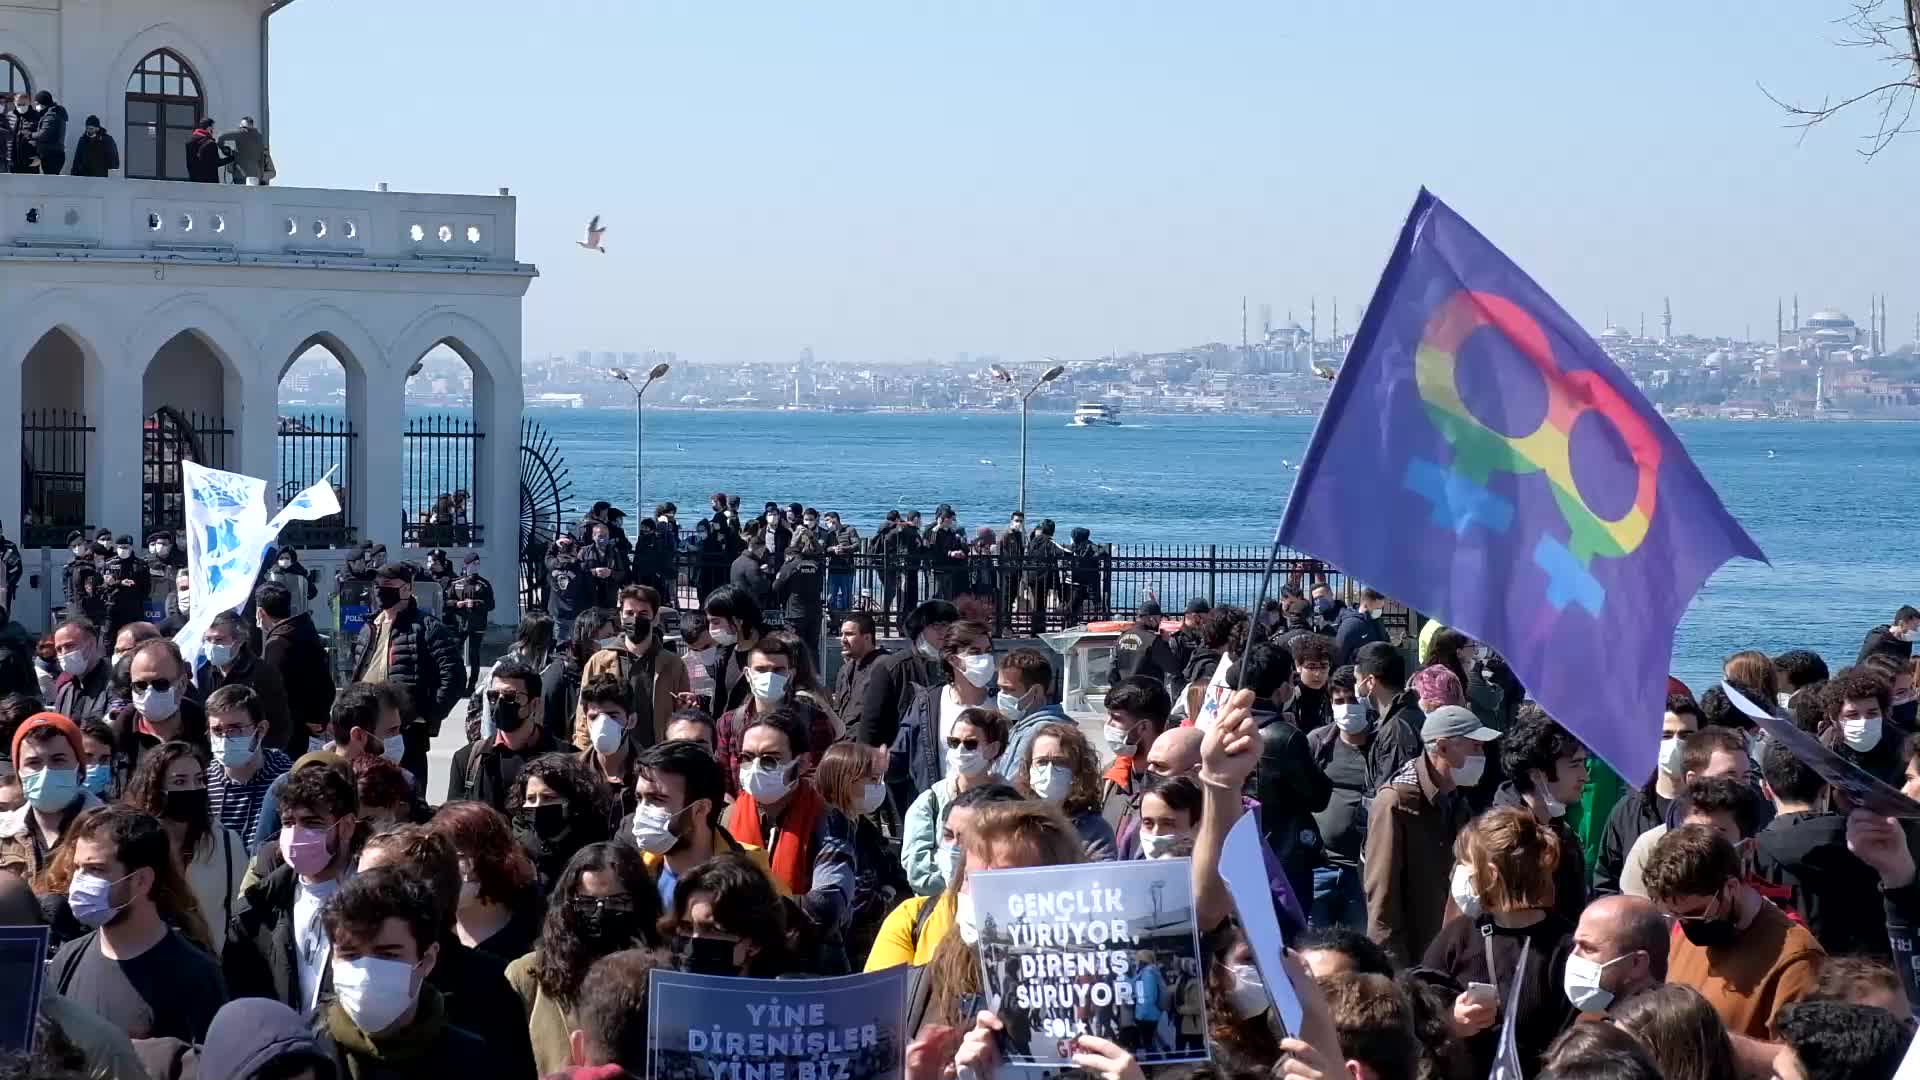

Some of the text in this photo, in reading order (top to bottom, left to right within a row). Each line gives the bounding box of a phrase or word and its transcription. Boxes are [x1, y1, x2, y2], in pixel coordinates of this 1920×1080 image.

[1008, 882, 1124, 921] GENÇLİK
[1008, 917, 1140, 947] YÜRÜYOR,
[1021, 944, 1129, 980] DİRENİŞ
[1016, 977, 1145, 1009] SÜRÜYOR!
[746, 997, 825, 1027] YİNE
[688, 1023, 879, 1057] DİRENİŞLER
[707, 1053, 851, 1080] YİNE BİZ
